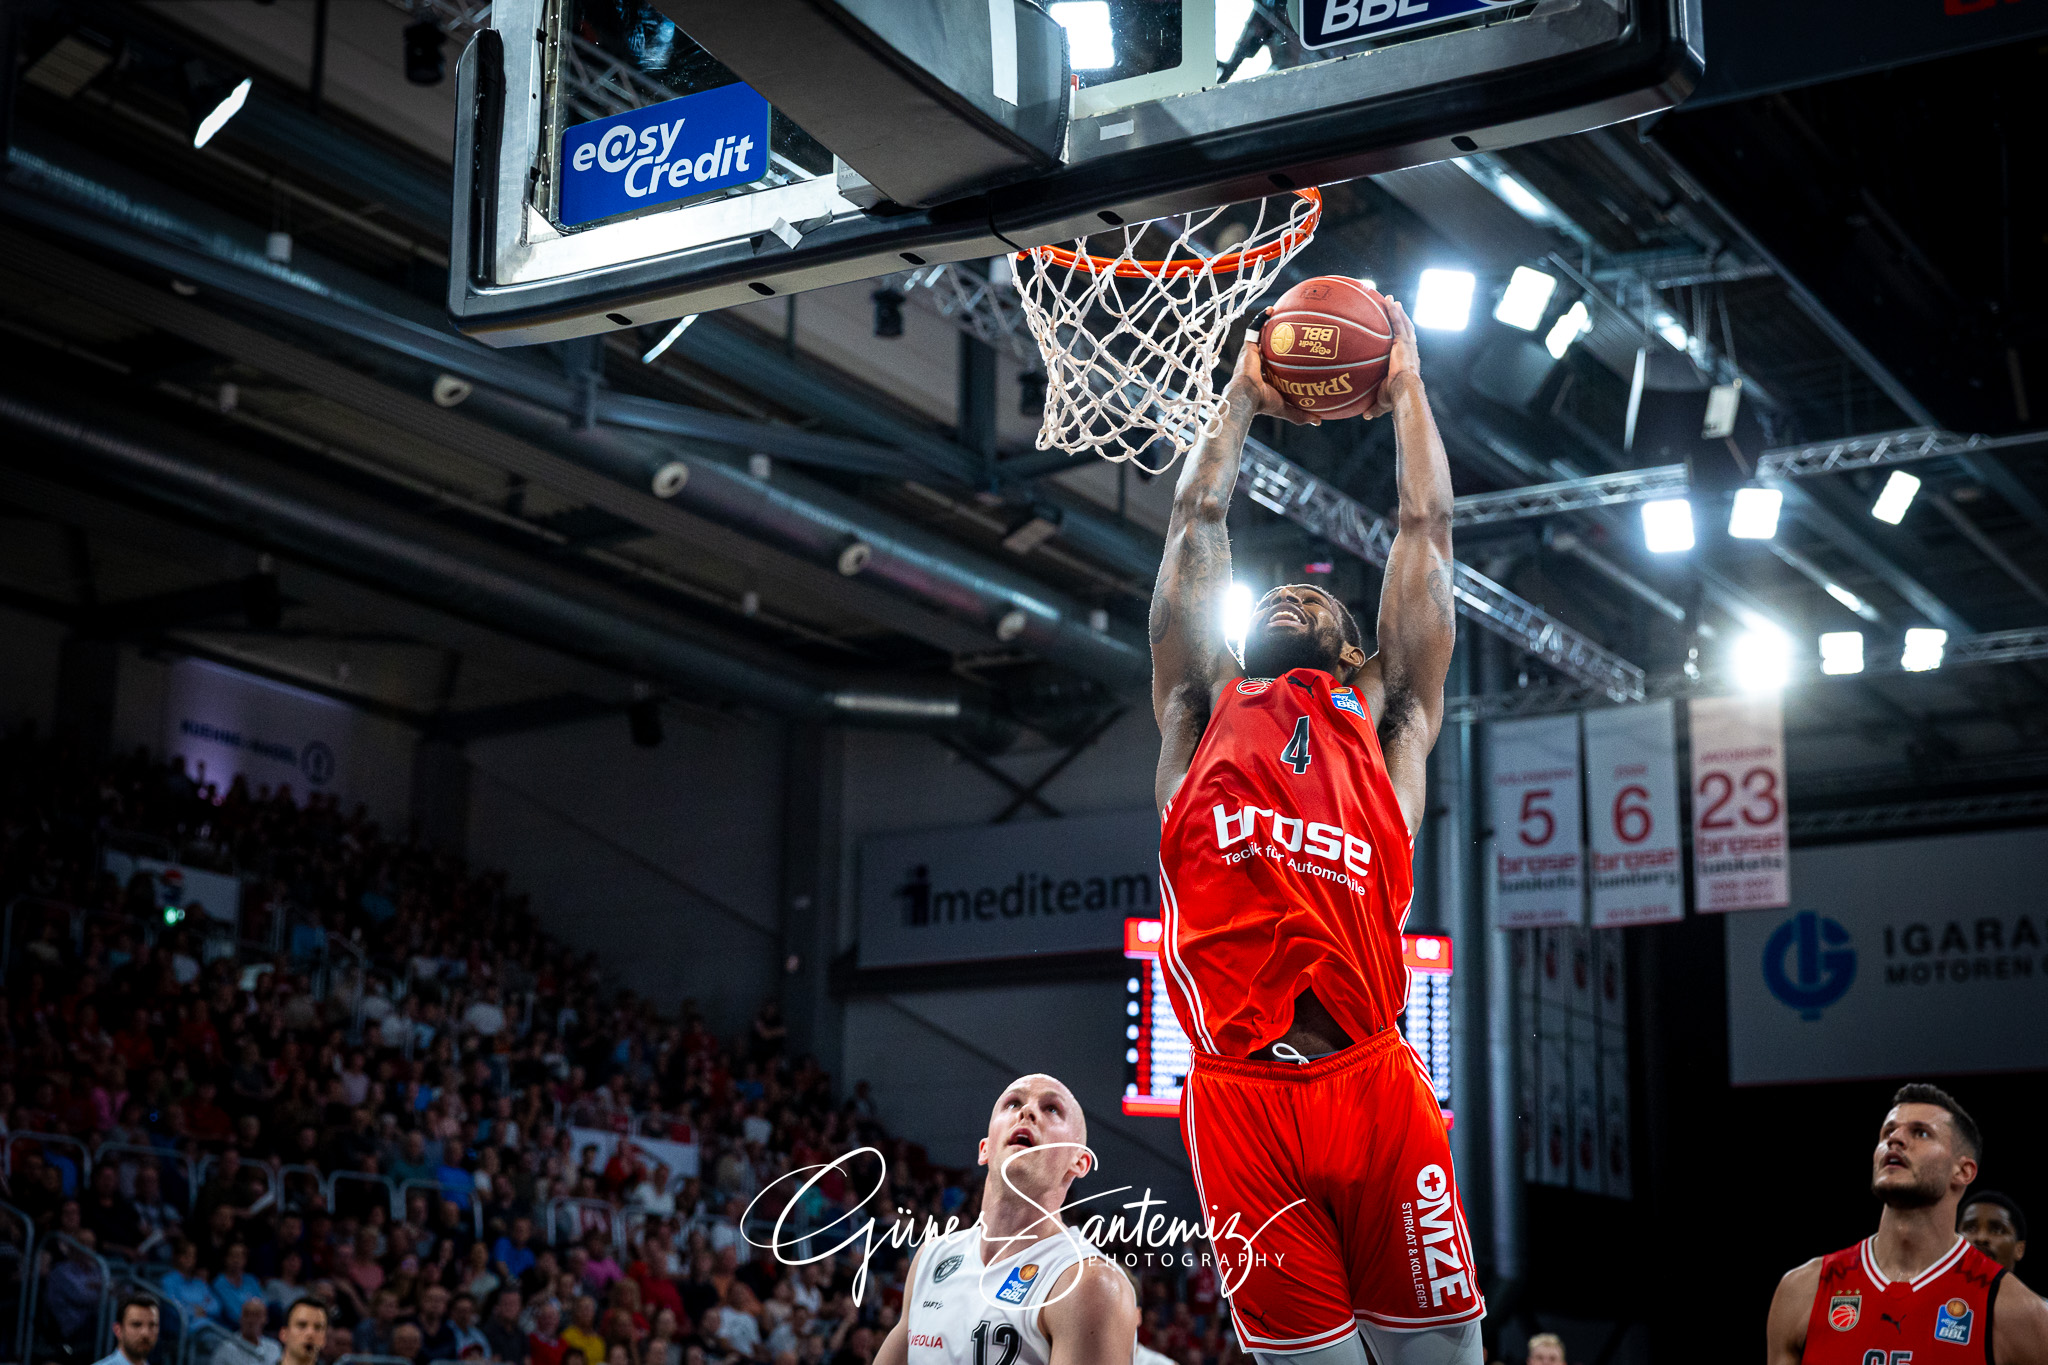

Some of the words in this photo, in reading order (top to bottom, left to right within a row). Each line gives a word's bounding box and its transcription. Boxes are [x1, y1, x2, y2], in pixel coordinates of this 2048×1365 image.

[624, 134, 754, 198] Credit
[1301, 327, 1334, 342] BBL
[1337, 700, 1362, 715] BBL
[1280, 715, 1312, 774] 4
[1519, 788, 1556, 846] 5
[1612, 785, 1653, 845] 6
[1698, 766, 1780, 830] 23
[1212, 803, 1372, 877] brose
[1221, 842, 1262, 865] Tecik
[1884, 915, 2048, 957] IGARA
[1884, 956, 2034, 986] MOTOREN
[1402, 1202, 1417, 1246] STIRKAT
[1408, 1248, 1419, 1257] &
[999, 1288, 1023, 1302] BBL
[1410, 1258, 1428, 1309] KOLLEGEN
[910, 1334, 943, 1349] VEOLIA
[970, 1320, 1022, 1365] 12
[1939, 1326, 1965, 1341] BBL
